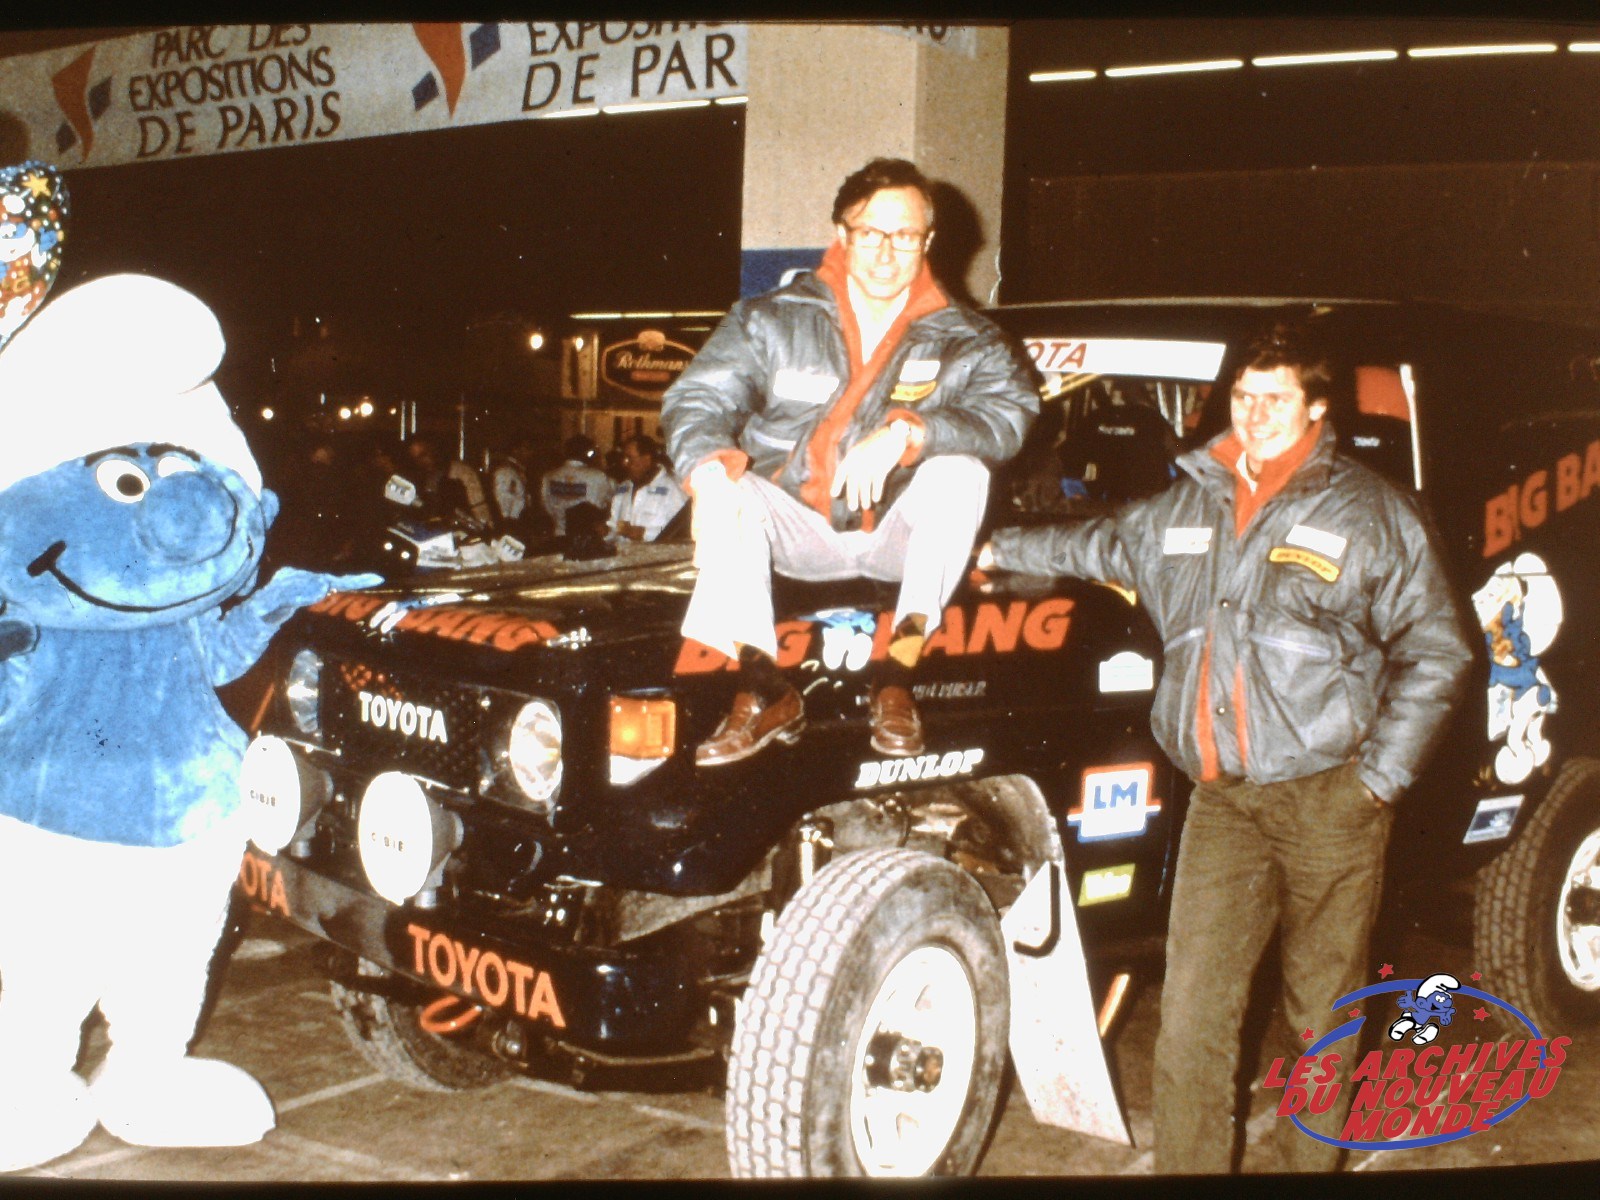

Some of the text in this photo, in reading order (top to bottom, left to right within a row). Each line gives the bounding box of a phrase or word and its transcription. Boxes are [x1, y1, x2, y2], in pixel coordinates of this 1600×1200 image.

[152, 25, 312, 69] PARC DES
[522, 33, 739, 112] DE PAR
[129, 46, 336, 112] EXPOSITIONS
[136, 91, 341, 159] DE PARIS
[1482, 470, 1548, 559] BIG
[358, 691, 448, 744] TOYOTA
[855, 748, 984, 789] DUNLOP
[1093, 781, 1139, 810] LM
[371, 831, 405, 853] CBIE
[407, 923, 566, 1027] TOYOTA
